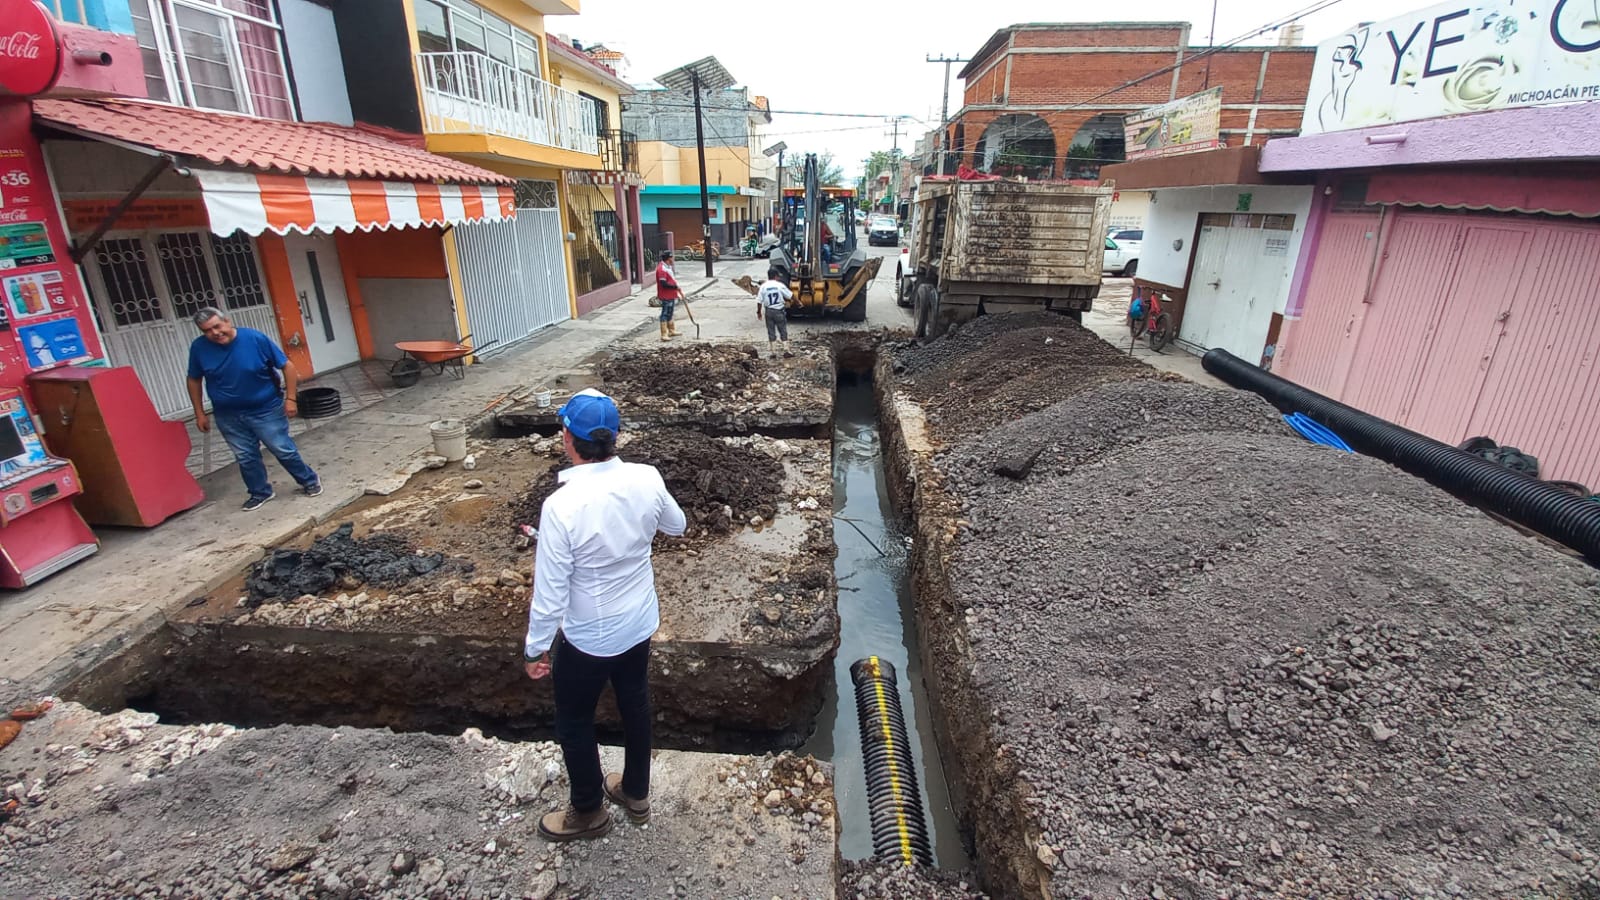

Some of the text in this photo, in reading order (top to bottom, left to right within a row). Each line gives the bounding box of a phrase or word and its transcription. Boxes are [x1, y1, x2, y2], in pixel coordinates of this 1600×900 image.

[1506, 83, 1579, 104] MICHOACÁN
[1, 172, 30, 186] $36
[767, 292, 780, 305] 12
